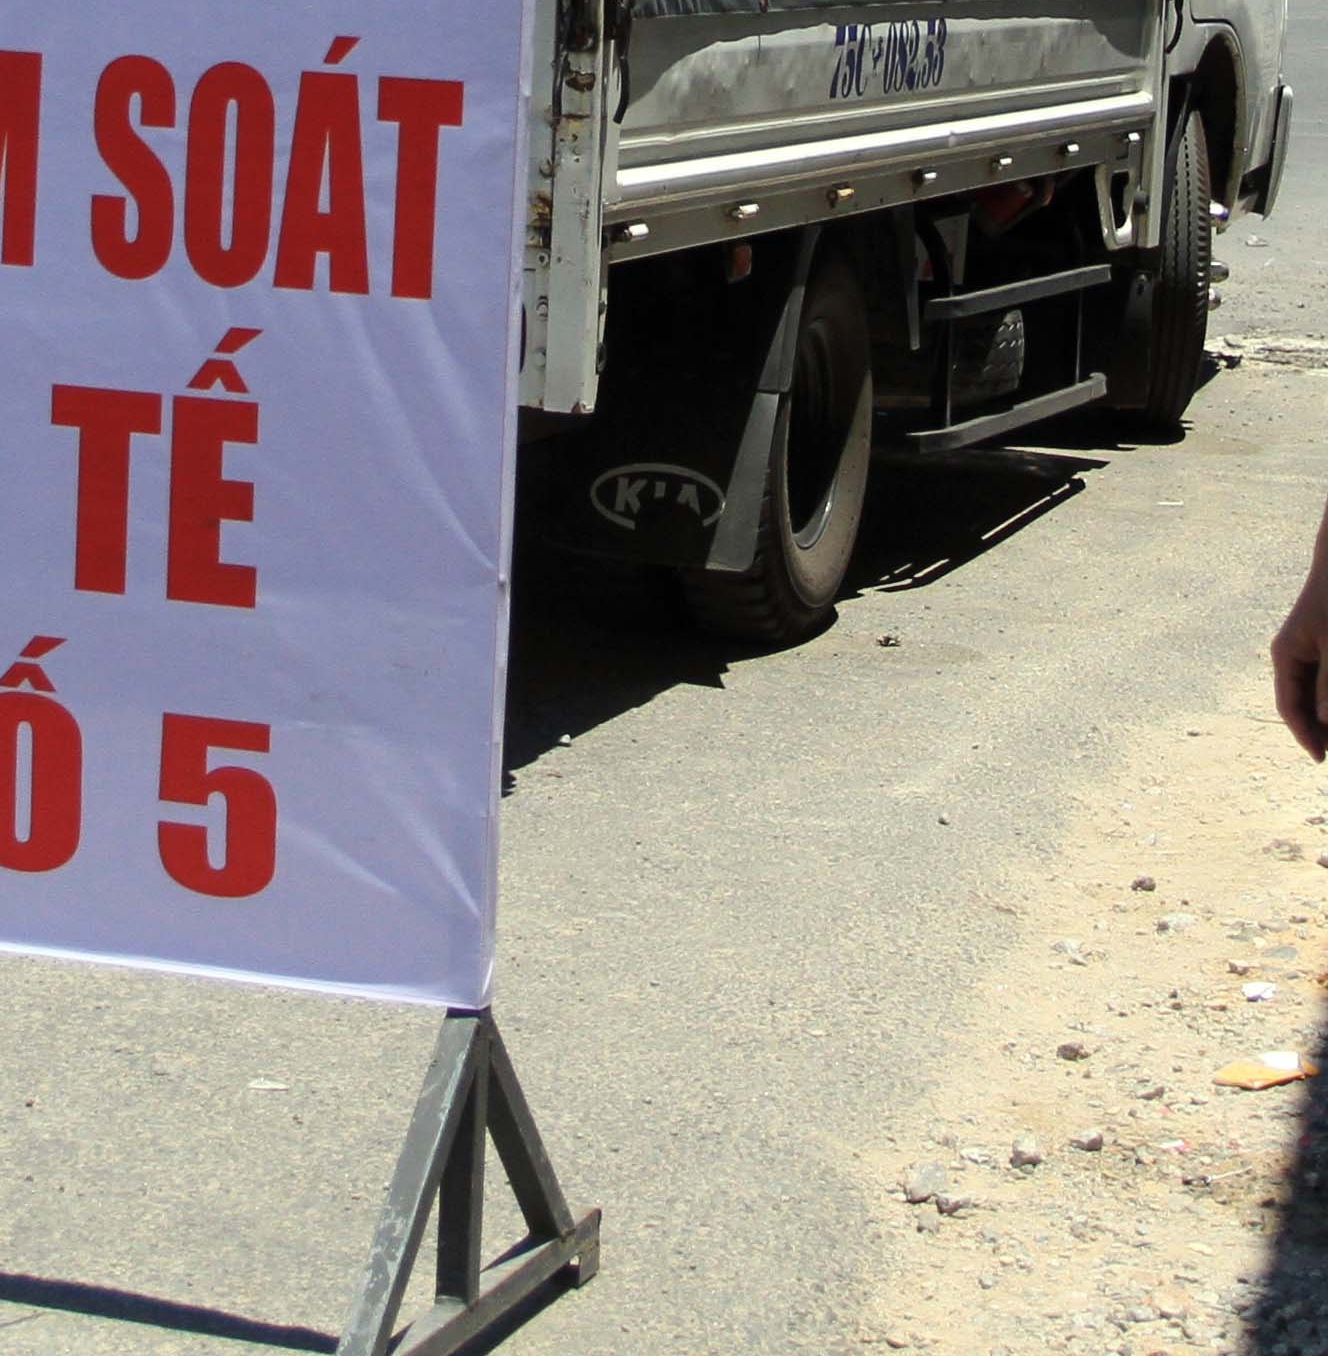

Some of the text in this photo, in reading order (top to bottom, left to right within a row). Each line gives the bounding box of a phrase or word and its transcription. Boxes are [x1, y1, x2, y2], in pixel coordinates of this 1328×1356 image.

[90, 36, 463, 300] SOÁT
[51, 327, 263, 608] TẾ
[613, 476, 701, 516] KIA
[157, 713, 277, 898] 5
